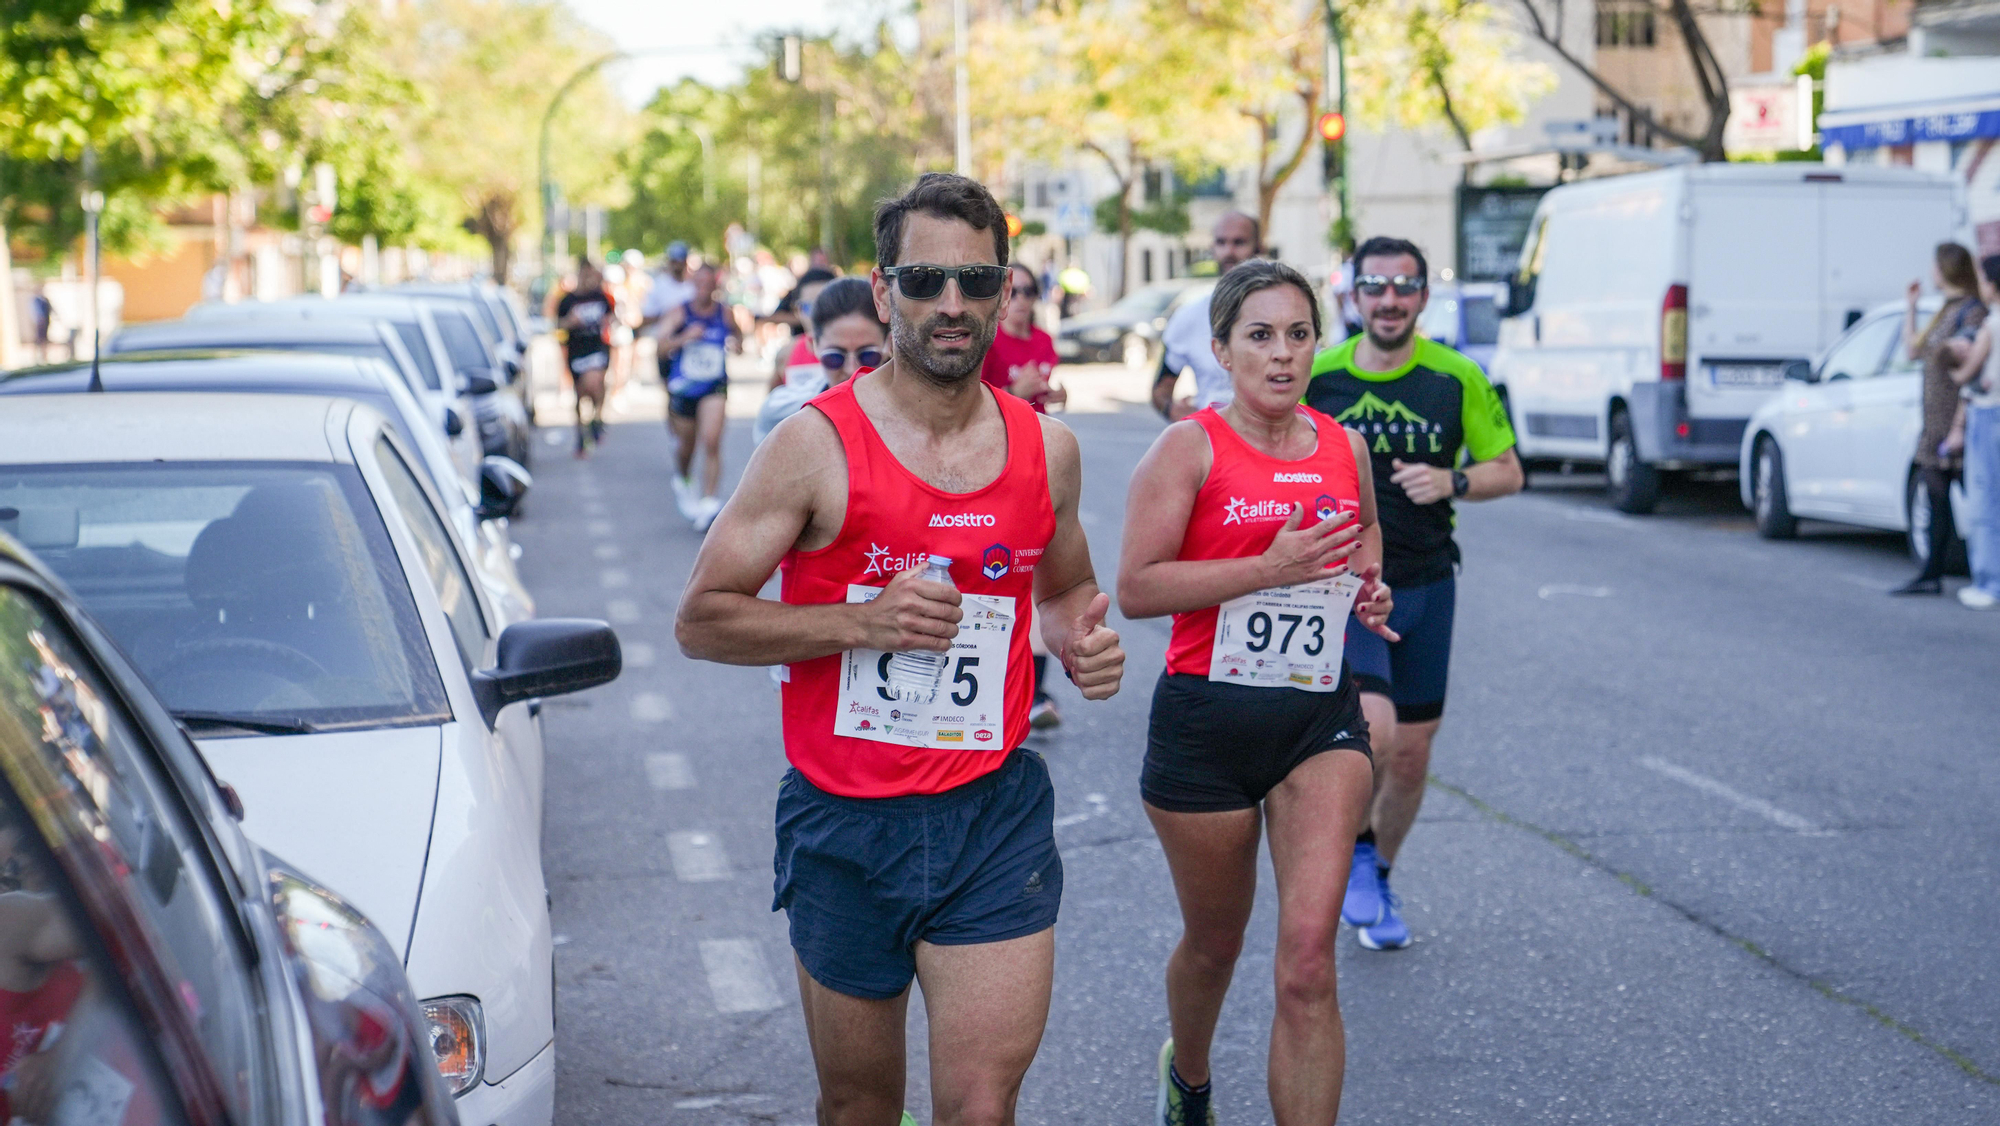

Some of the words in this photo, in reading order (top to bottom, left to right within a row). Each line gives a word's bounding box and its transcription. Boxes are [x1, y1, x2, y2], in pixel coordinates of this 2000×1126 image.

[1373, 433, 1443, 453] AIL
[1273, 472, 1323, 484] Mosttro
[1240, 499, 1291, 518] califas
[928, 512, 996, 527] Mosttro
[883, 552, 929, 572] calif
[1246, 611, 1325, 656] 973
[857, 705, 880, 715] califas
